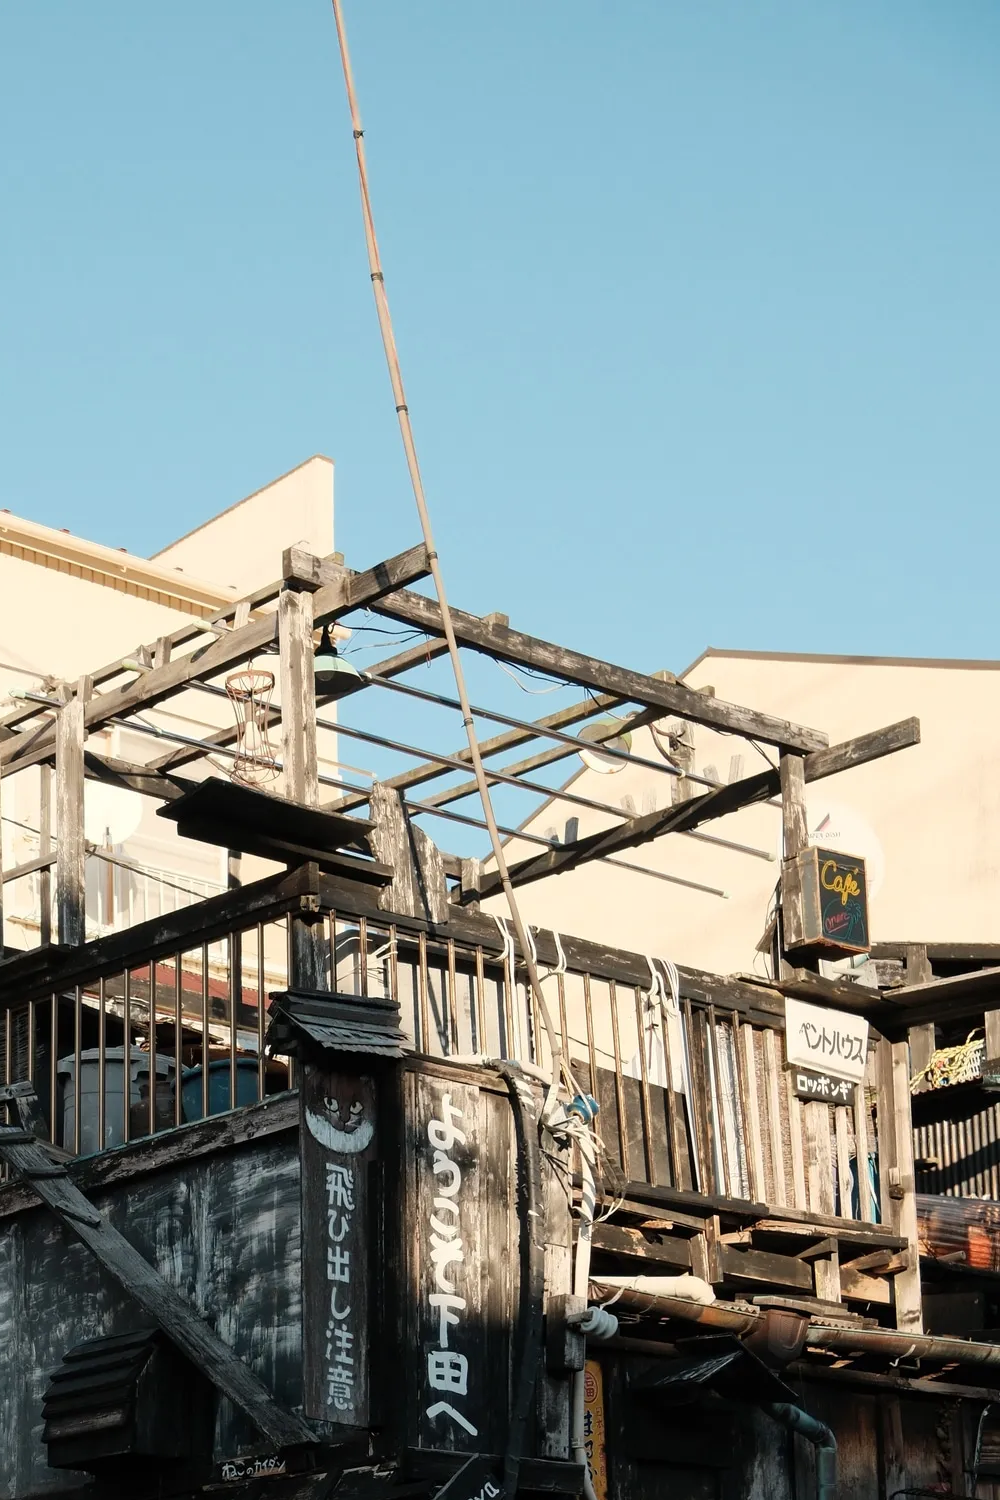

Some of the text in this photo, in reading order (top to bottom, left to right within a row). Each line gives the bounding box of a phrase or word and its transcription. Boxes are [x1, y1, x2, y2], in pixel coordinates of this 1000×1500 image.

[799, 1022, 866, 1063] ペントハウス
[796, 1073, 852, 1101] ロッポンギ
[326, 1163, 356, 1411] 飛び出し注意
[222, 1457, 286, 1479] ねこのカイダン
